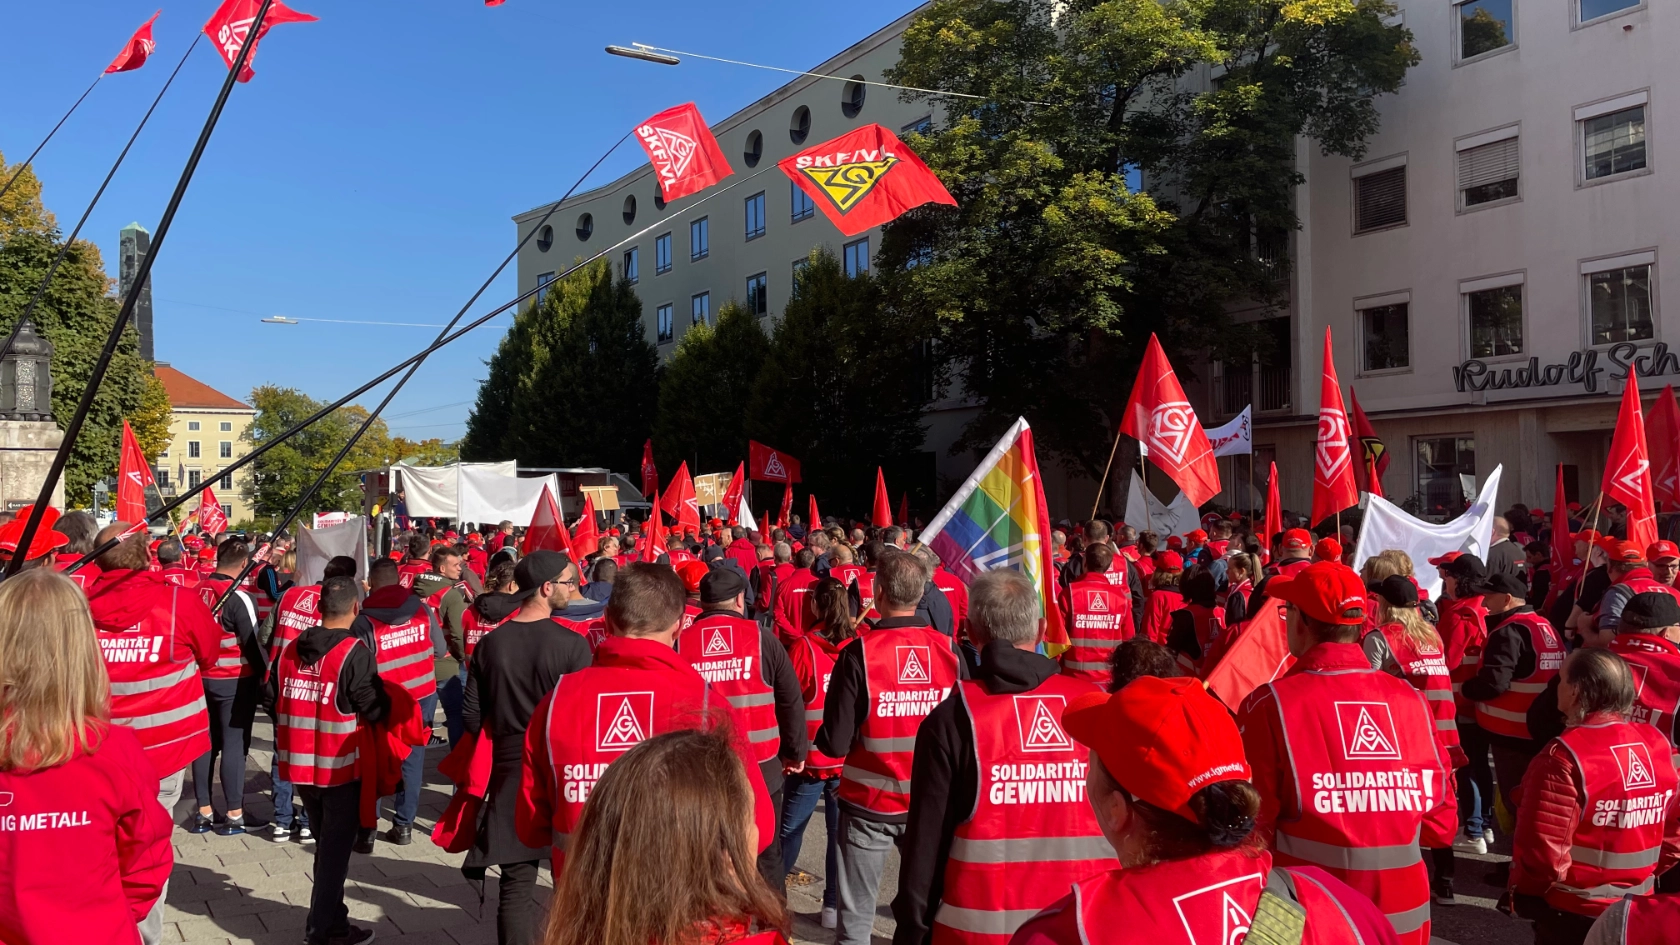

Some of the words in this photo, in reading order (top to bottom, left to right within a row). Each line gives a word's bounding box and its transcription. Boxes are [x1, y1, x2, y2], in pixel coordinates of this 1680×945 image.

[637, 125, 676, 192] SKF/VL
[796, 145, 894, 169] SKF/VL
[1453, 349, 1604, 392] Rudolf
[1076, 613, 1115, 621] SOLIDARITÄT
[380, 626, 419, 642] SOLIDARITÄT
[878, 688, 940, 702] SOLIDARITÄT
[991, 759, 1087, 781] SOLIDARITÄT
[1312, 768, 1418, 789] SOLIDARITÄT
[1595, 793, 1664, 812] SOLIDARITÄT
[1, 814, 16, 832] IG
[19, 810, 92, 831] METALL
